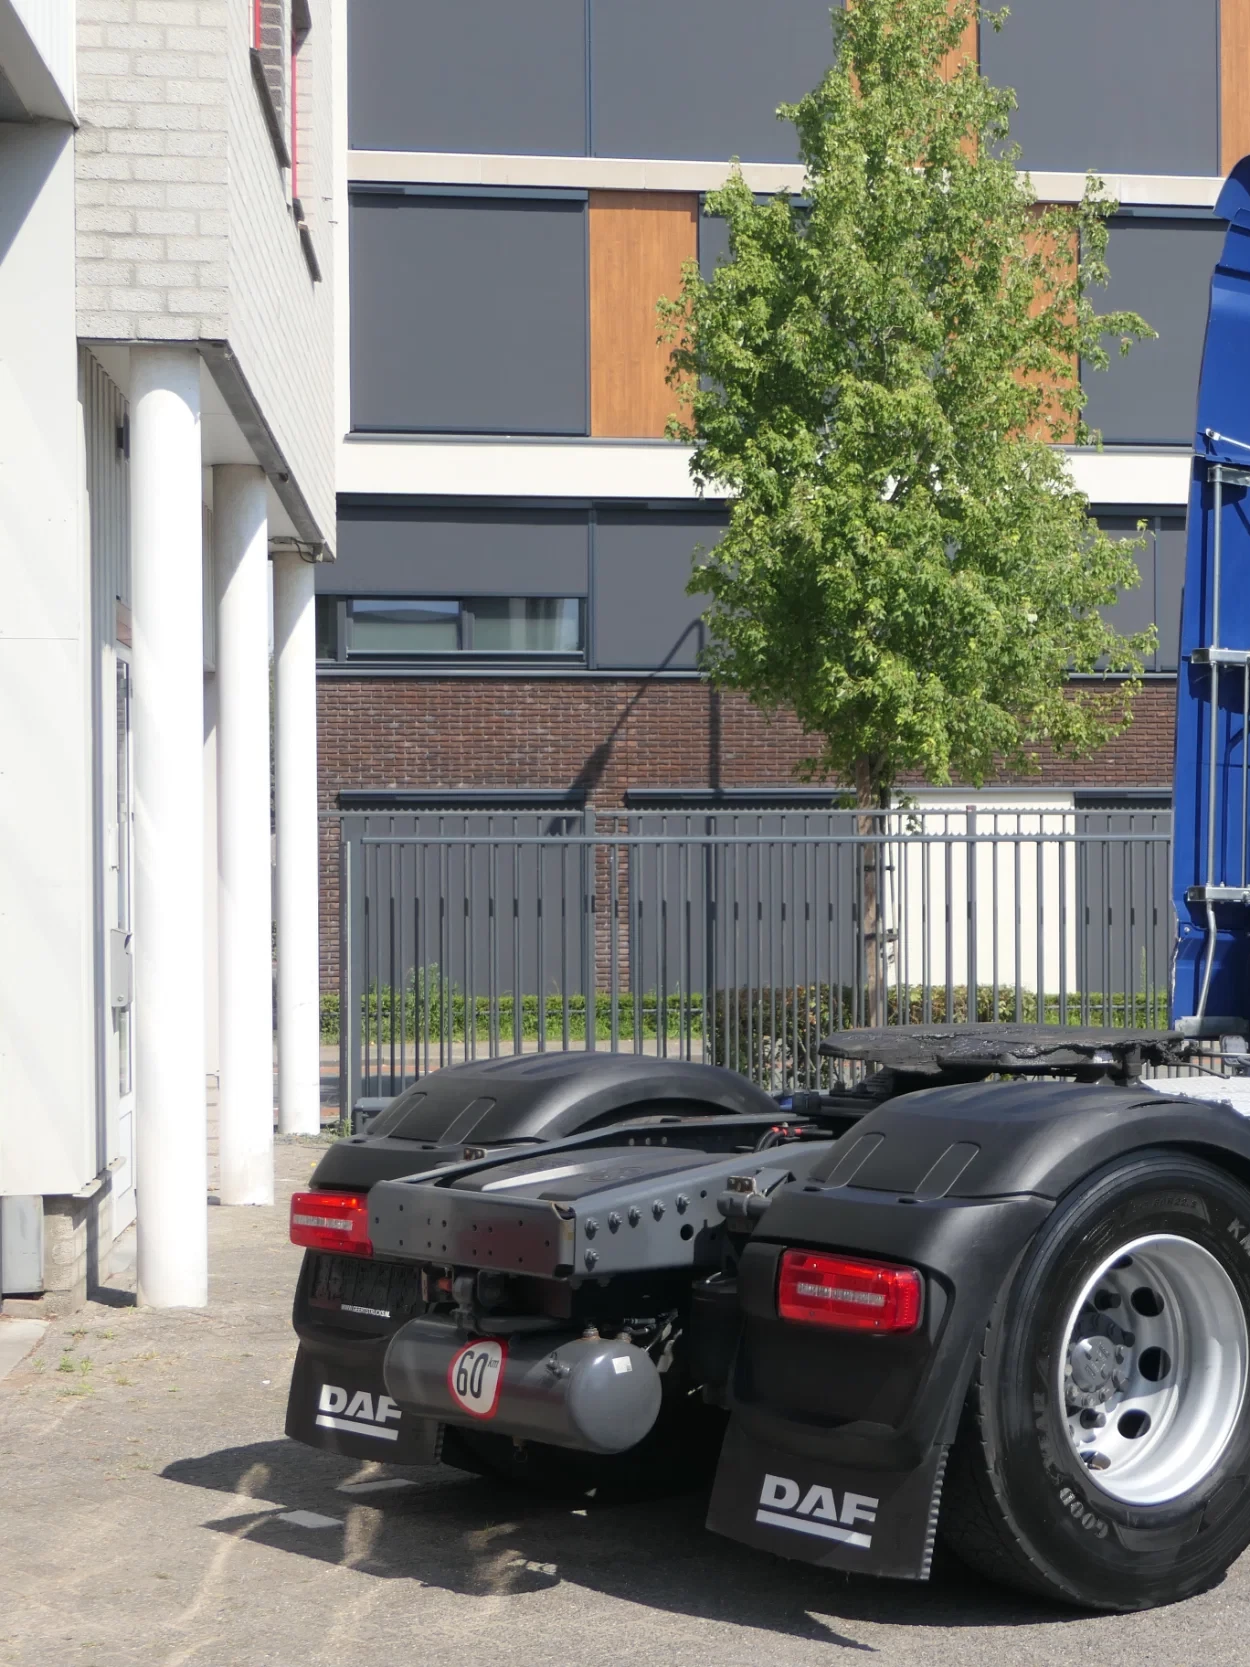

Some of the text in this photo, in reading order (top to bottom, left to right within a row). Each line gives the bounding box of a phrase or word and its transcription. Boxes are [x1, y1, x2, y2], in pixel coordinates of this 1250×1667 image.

[456, 1350, 500, 1399] 60 km
[318, 1383, 402, 1423] DAF
[759, 1473, 879, 1525] DAF
[1059, 1487, 1109, 1539] GOOD
